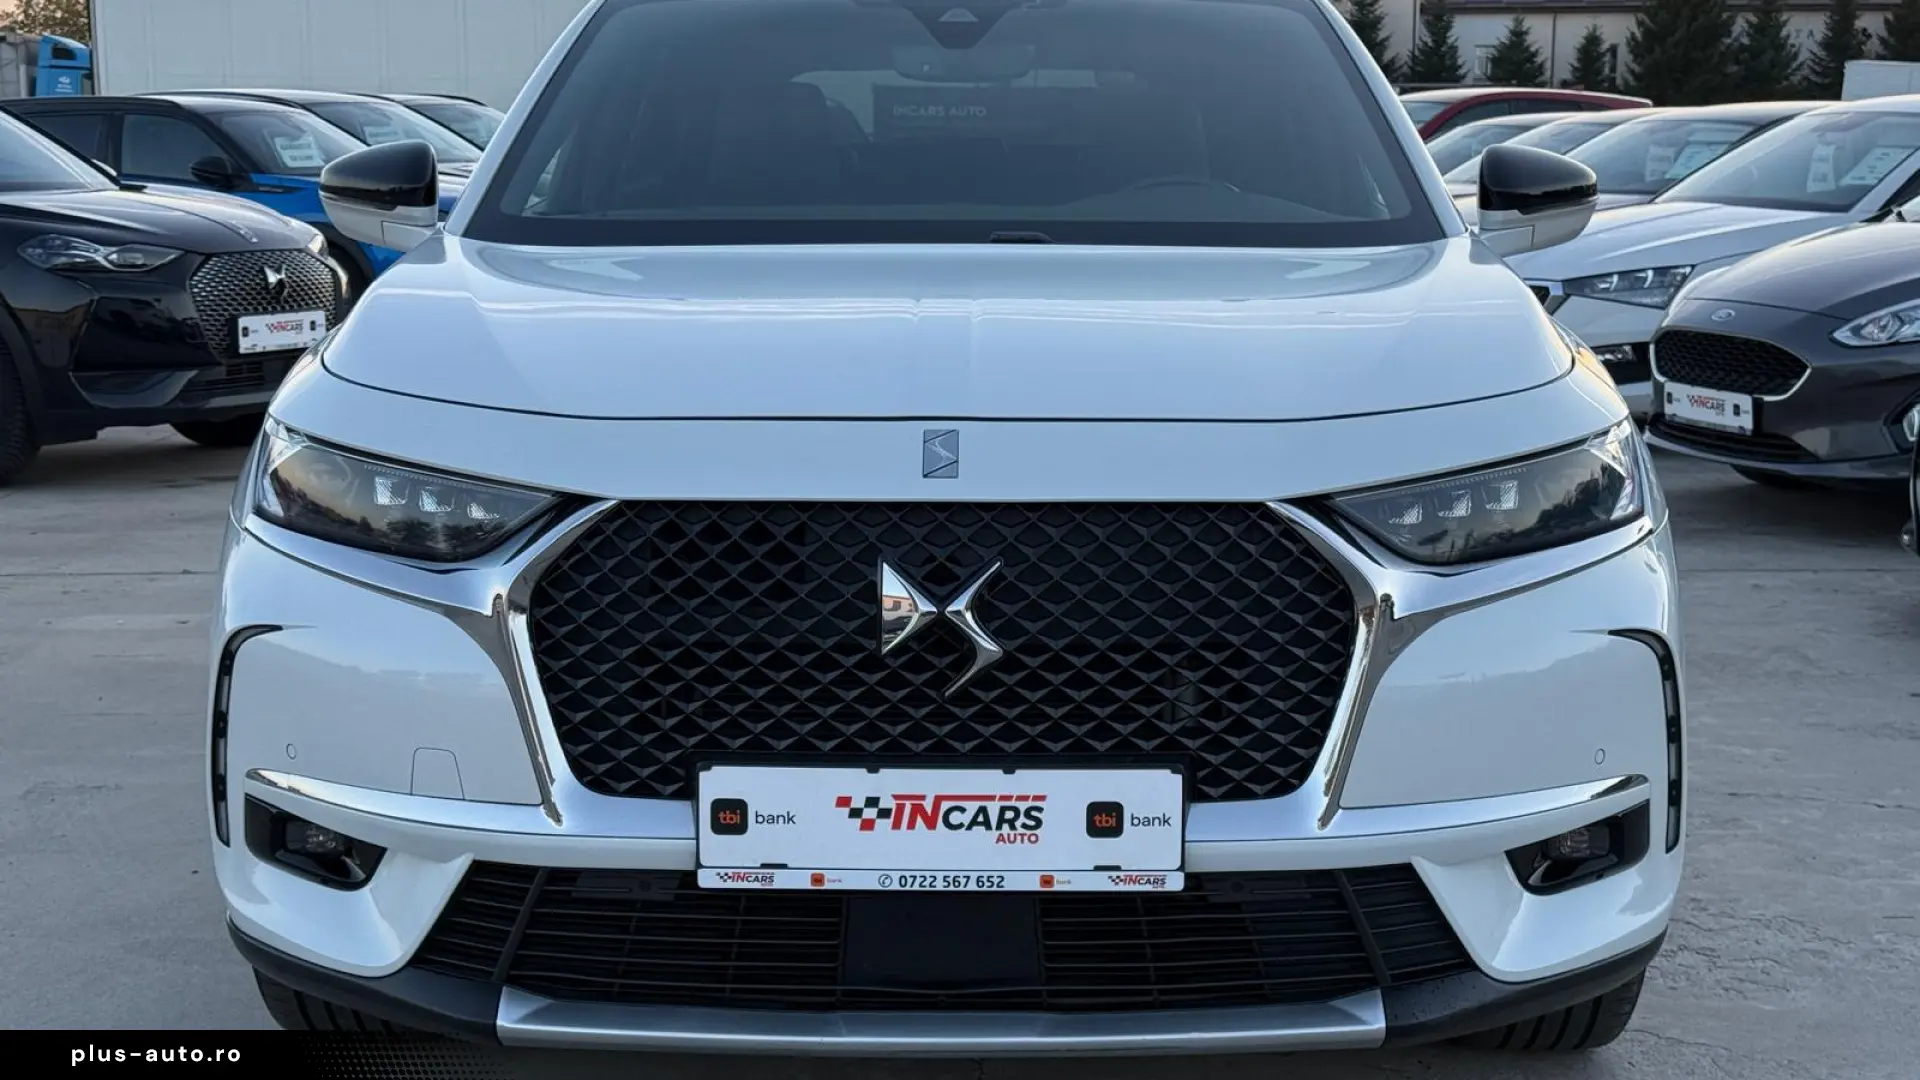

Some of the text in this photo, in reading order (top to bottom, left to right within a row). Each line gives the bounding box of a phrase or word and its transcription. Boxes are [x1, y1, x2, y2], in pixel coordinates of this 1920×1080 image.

[948, 105, 987, 117] AUTO
[717, 809, 796, 825] tbi bank
[891, 794, 1047, 832] INCARS
[1093, 812, 1172, 828] tbi bank
[995, 833, 1039, 845] AUTO
[731, 872, 775, 883] INCARS
[898, 875, 1005, 889] 0722 567 652
[1122, 874, 1167, 886] INCARS
